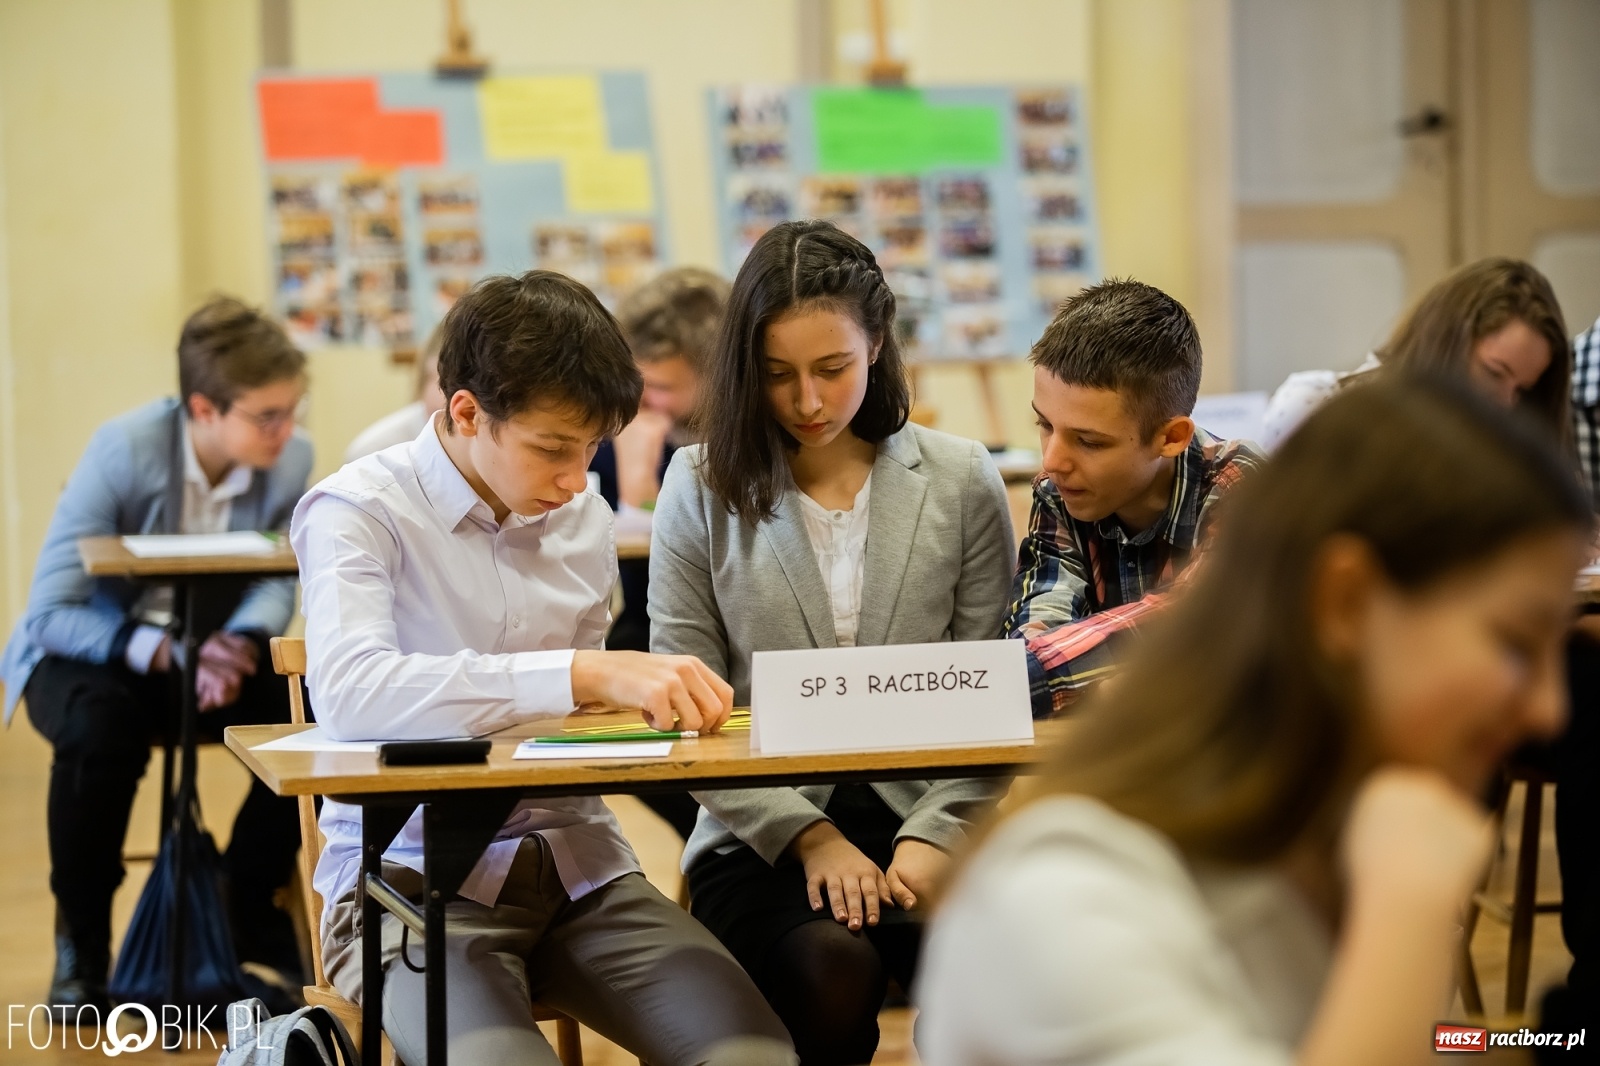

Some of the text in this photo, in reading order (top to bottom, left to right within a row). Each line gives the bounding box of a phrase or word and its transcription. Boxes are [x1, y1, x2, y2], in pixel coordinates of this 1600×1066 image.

[800, 665, 989, 698] SP 3 RACIBÓRZ
